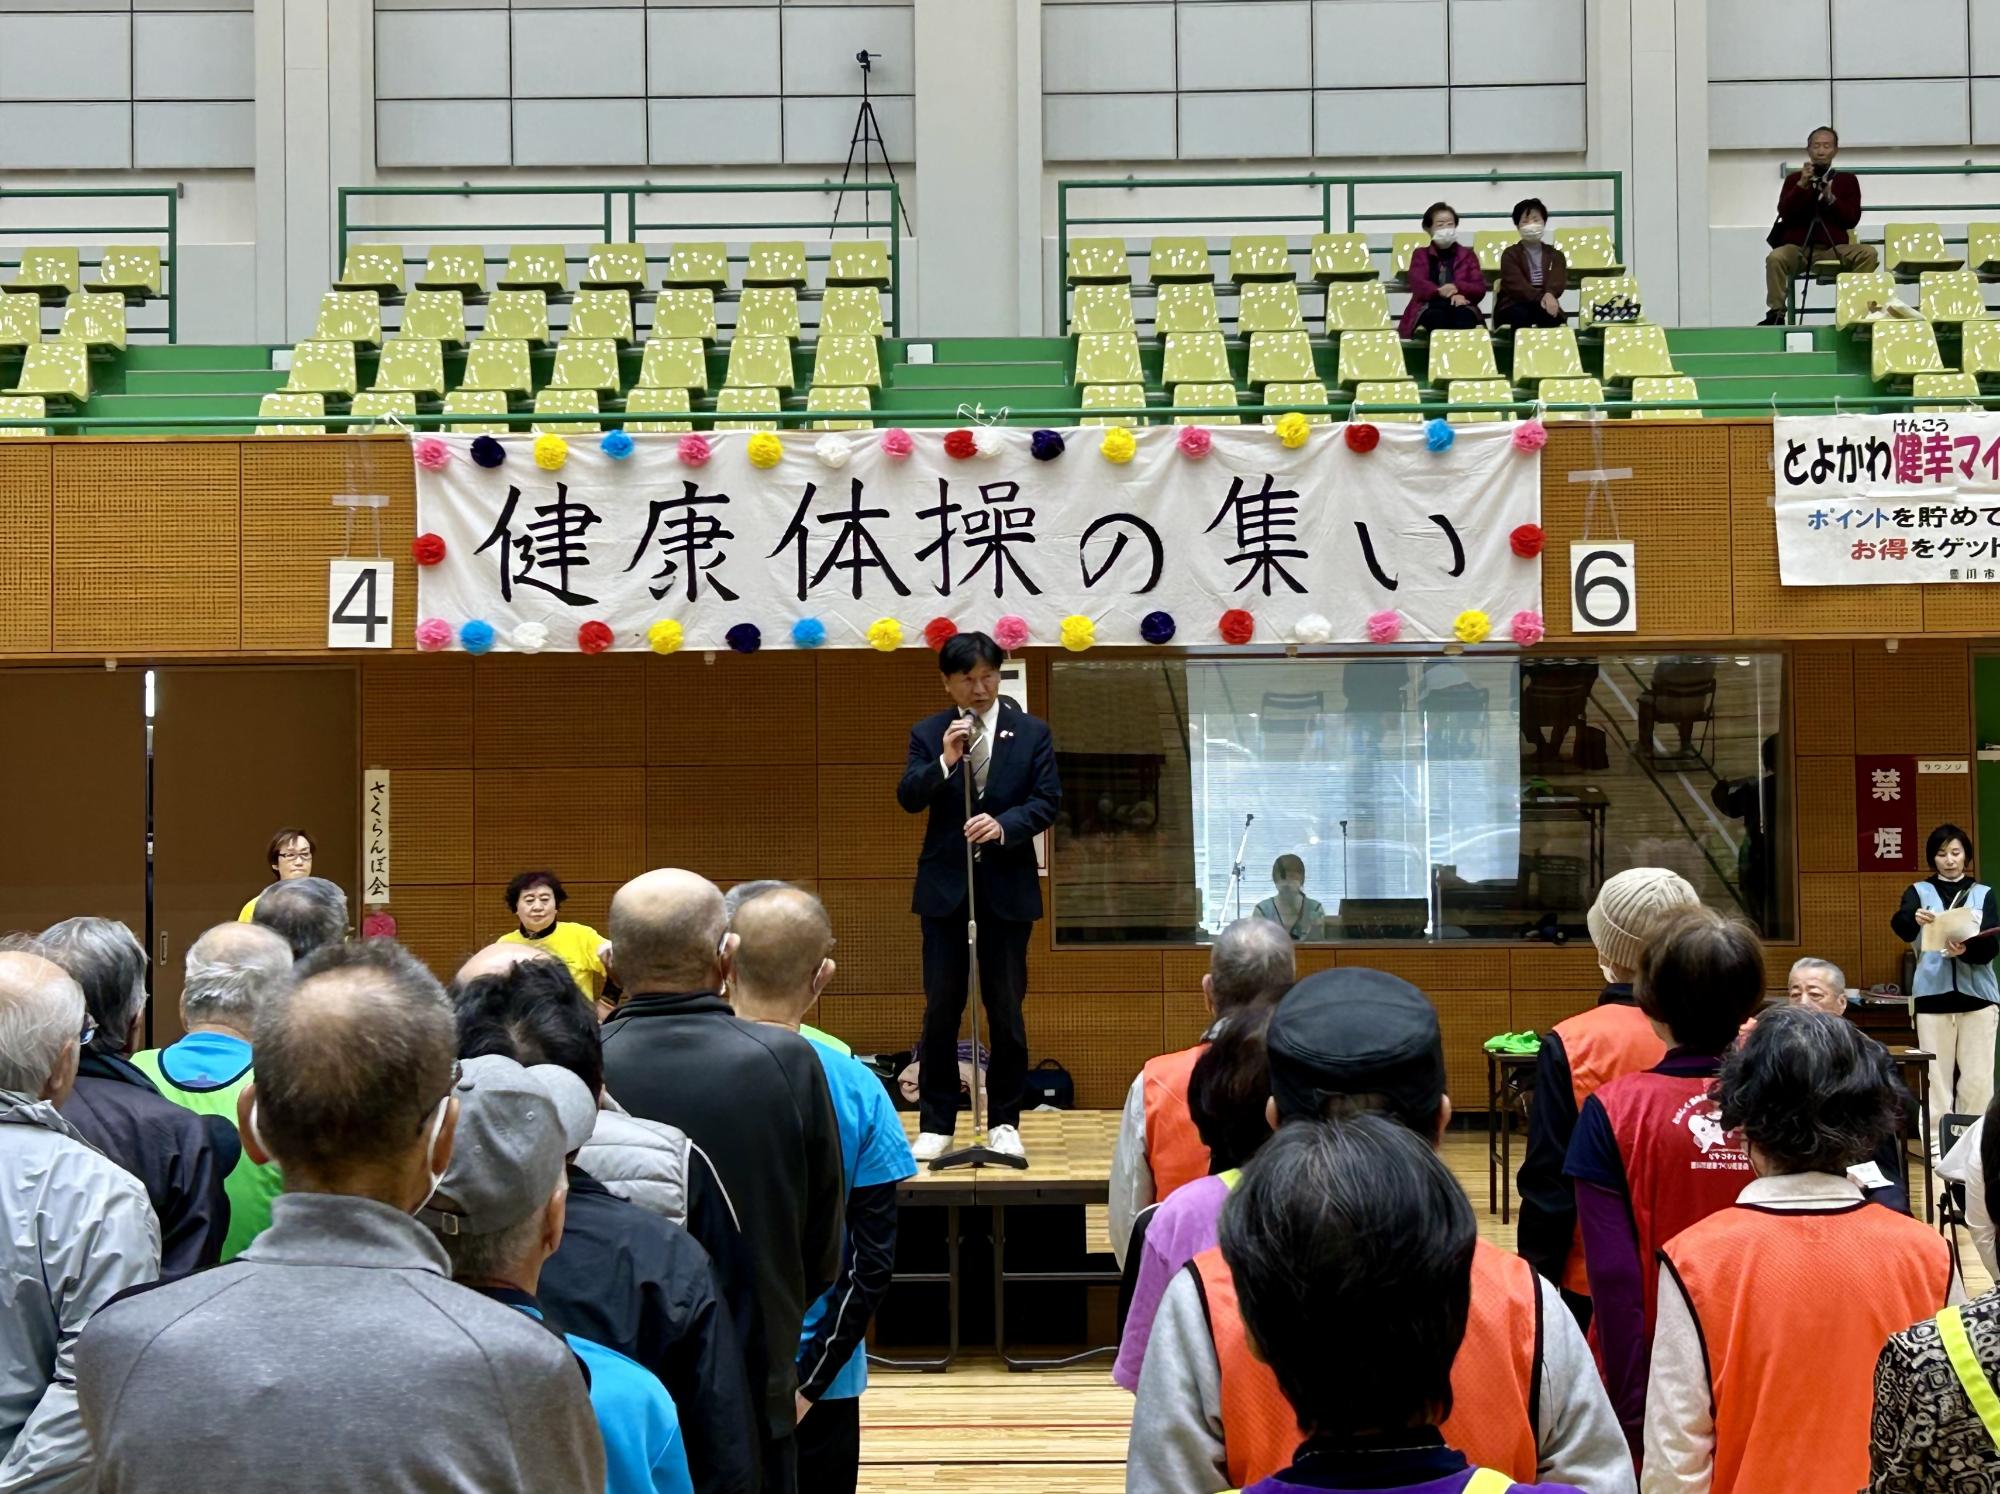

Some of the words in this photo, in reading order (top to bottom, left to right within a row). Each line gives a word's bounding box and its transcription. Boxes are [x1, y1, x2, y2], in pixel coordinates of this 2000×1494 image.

[1893, 419, 1949, 432] けんこう
[473, 473, 1465, 606] 健康体操の集い
[1807, 506, 2000, 530] ポイントを貯めて
[331, 568, 388, 643] 4
[1575, 550, 1630, 628] 6
[1871, 768, 1903, 859] 禁煙
